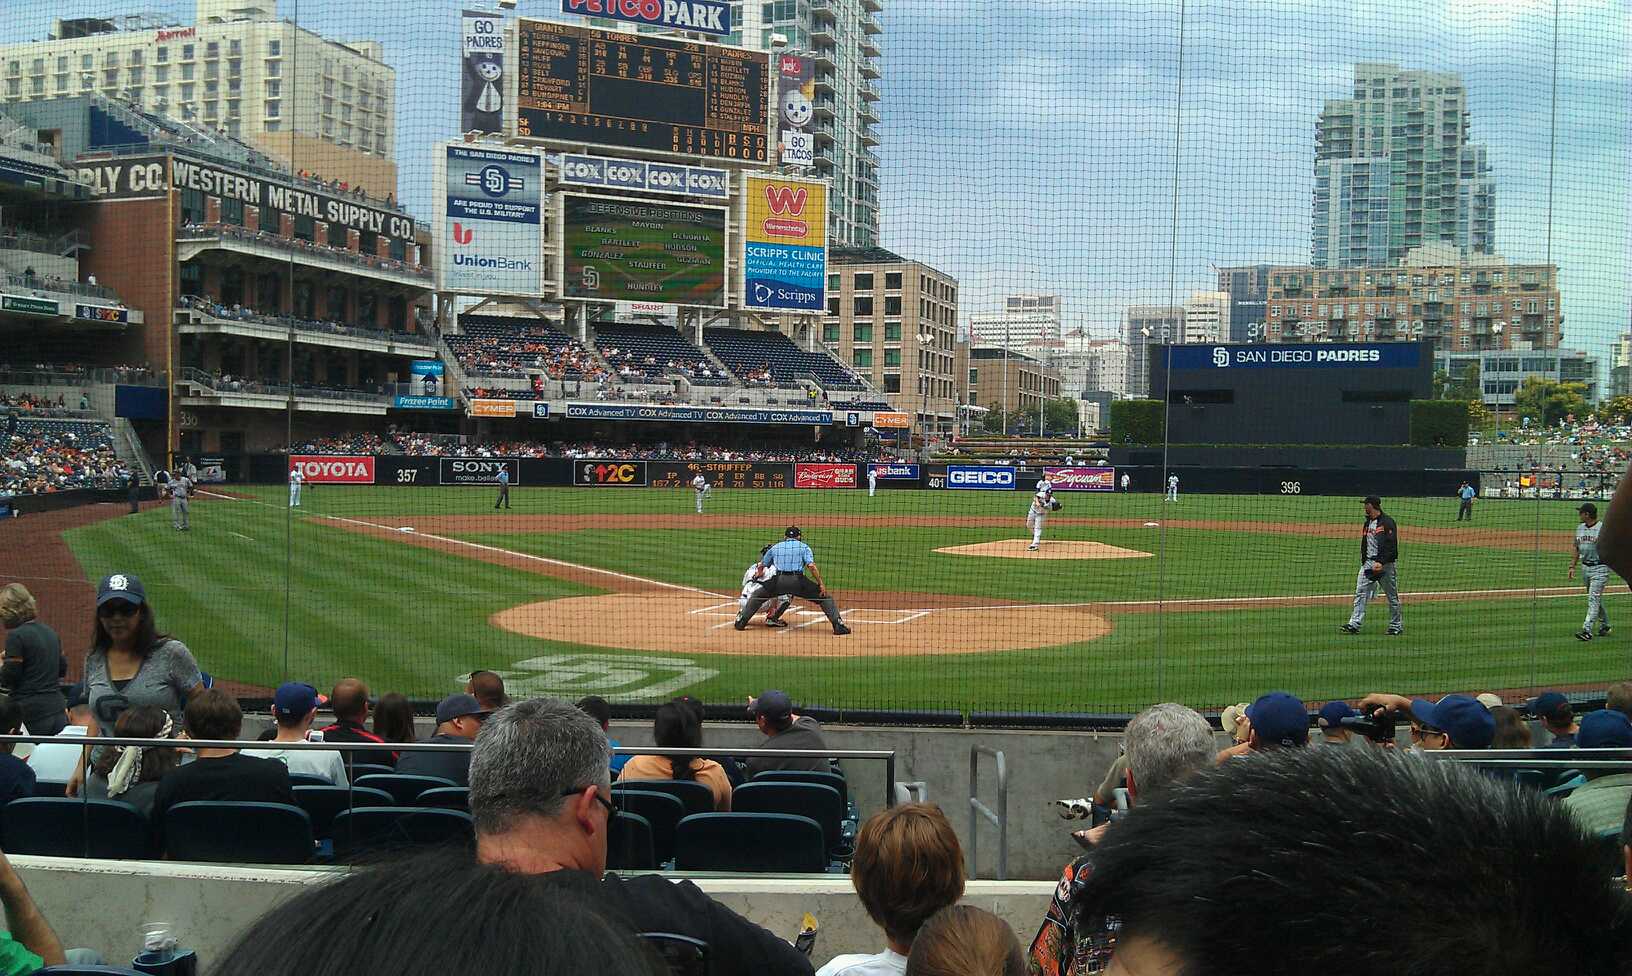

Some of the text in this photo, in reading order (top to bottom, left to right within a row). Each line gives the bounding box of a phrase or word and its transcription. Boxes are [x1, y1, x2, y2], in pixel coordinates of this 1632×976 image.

[663, 0, 724, 31] PARK
[474, 20, 494, 34] GO
[466, 36, 503, 48] PADRES
[607, 32, 638, 43] TORRES
[722, 49, 752, 60] PADRES
[519, 117, 529, 126] SF
[519, 127, 531, 136] SD
[791, 136, 806, 148] GO
[454, 149, 535, 163] THE SAN DIEGO PADRES
[728, 147, 764, 160] 0 0 0
[787, 149, 813, 160] TACOS
[565, 162, 601, 179] COX
[607, 166, 643, 183] COX
[649, 170, 685, 187] COX
[690, 174, 724, 190] COX
[172, 160, 415, 242] WESTERN METAL SUPPLY CO.
[453, 199, 536, 213] ARE PROUD TO SUPPORT
[765, 184, 808, 216] W
[479, 208, 493, 216] U.S.
[494, 210, 526, 218] MILITARY
[590, 202, 704, 223] DEFENSIVE POSITIONS
[585, 225, 617, 234] BLANKS
[632, 221, 664, 230] MAYBIN
[581, 250, 624, 260] GONZALEZ
[747, 247, 824, 262] SCRIPPS CLINIC
[629, 261, 666, 270] STAUFFER
[747, 267, 777, 275] PROVIDER
[777, 288, 816, 304] Scripps
[1236, 350, 1266, 363] SAN
[1271, 350, 1312, 362] DIEGO
[1316, 349, 1380, 362] PADRES
[400, 397, 448, 406] Frazee Paint
[475, 405, 514, 413] CYMER
[568, 407, 635, 417] COX Advanced TV
[639, 408, 703, 419] COX Advanced TV
[706, 411, 768, 421] COX Advanced TV
[770, 413, 830, 422] COX Advanced TV
[296, 462, 368, 479] TOYOTA
[452, 461, 508, 472] SONY
[397, 469, 417, 483] 357
[950, 471, 1012, 484] GEICO
[1051, 469, 1105, 487] Sycuan
[928, 478, 944, 488] 401
[1280, 481, 1301, 494] 396
